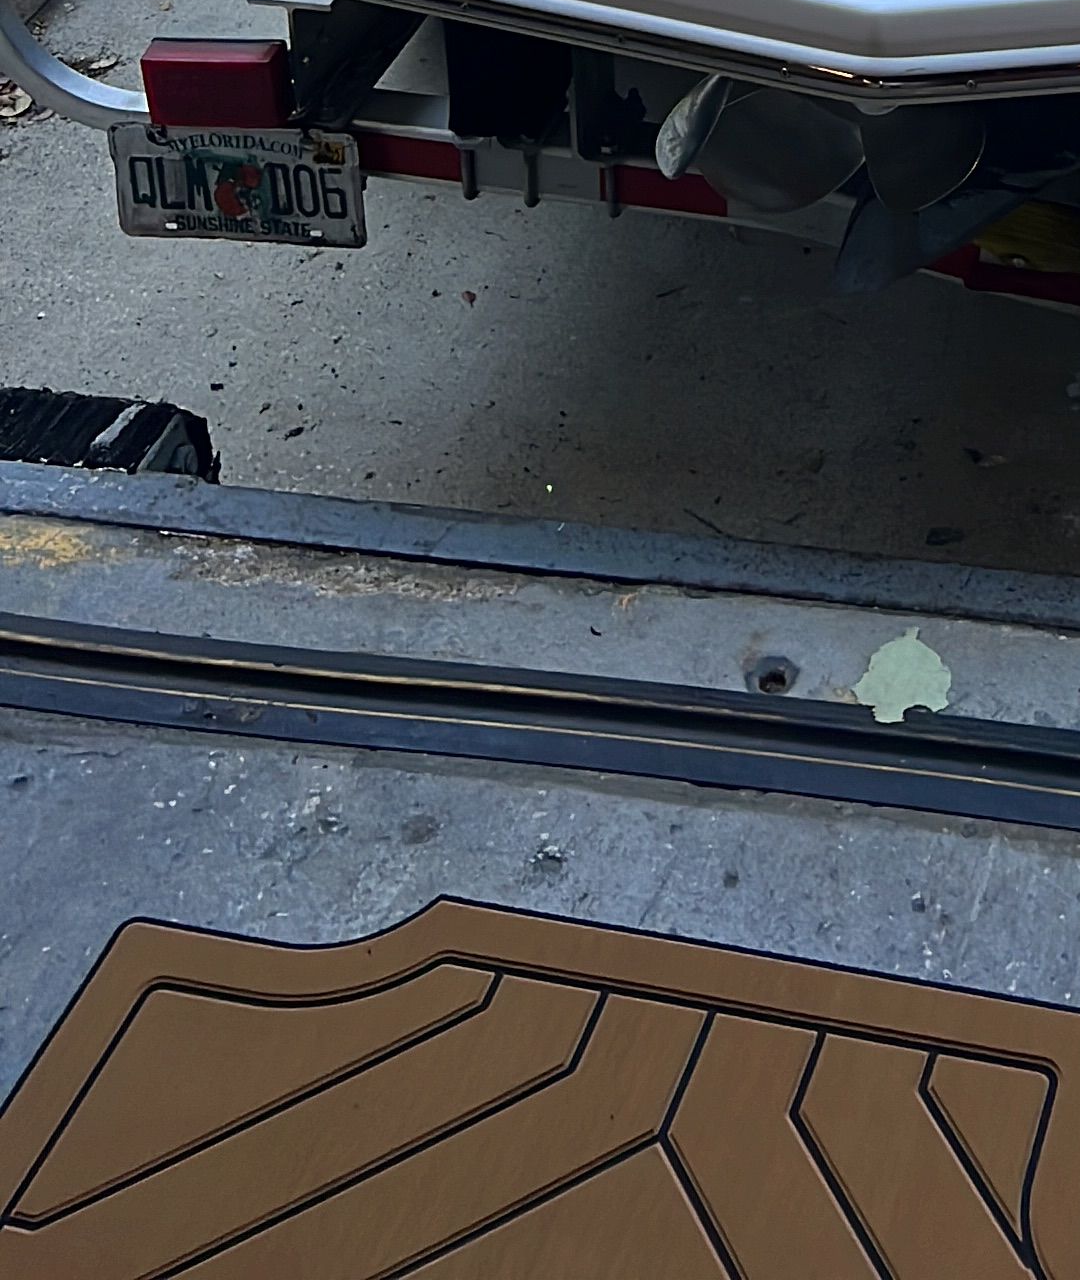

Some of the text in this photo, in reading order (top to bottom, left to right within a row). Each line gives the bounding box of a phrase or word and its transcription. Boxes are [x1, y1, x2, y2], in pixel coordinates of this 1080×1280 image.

[129, 156, 214, 212] QLM
[175, 214, 311, 239] SUNSHINE STATE
